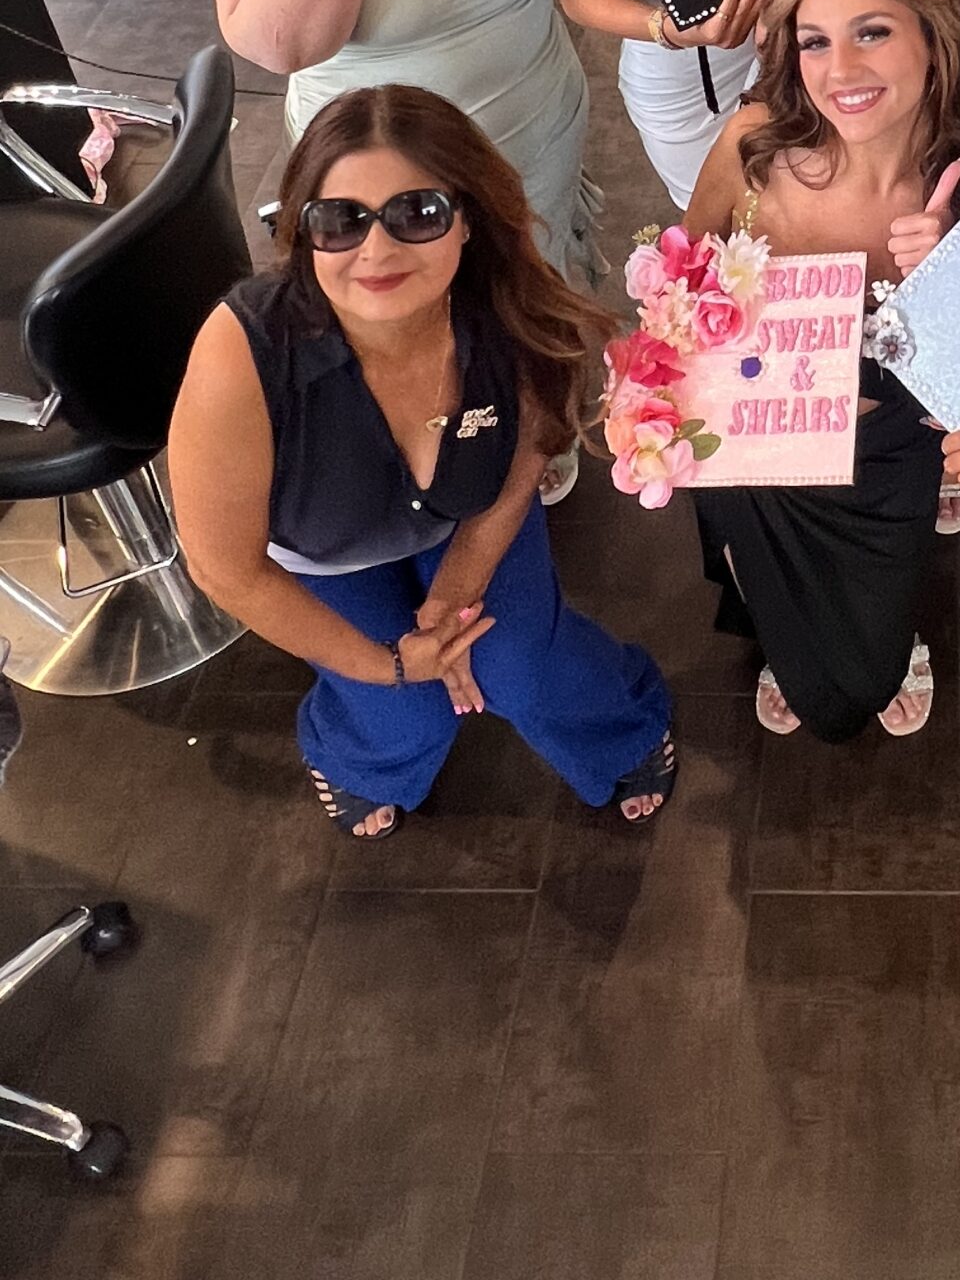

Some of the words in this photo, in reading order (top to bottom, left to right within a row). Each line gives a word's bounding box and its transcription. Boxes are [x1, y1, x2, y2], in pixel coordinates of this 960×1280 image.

[766, 264, 863, 303] BLOOD
[755, 314, 856, 354] SWEAT
[790, 355, 816, 392] &
[727, 395, 851, 436] SHEARS
